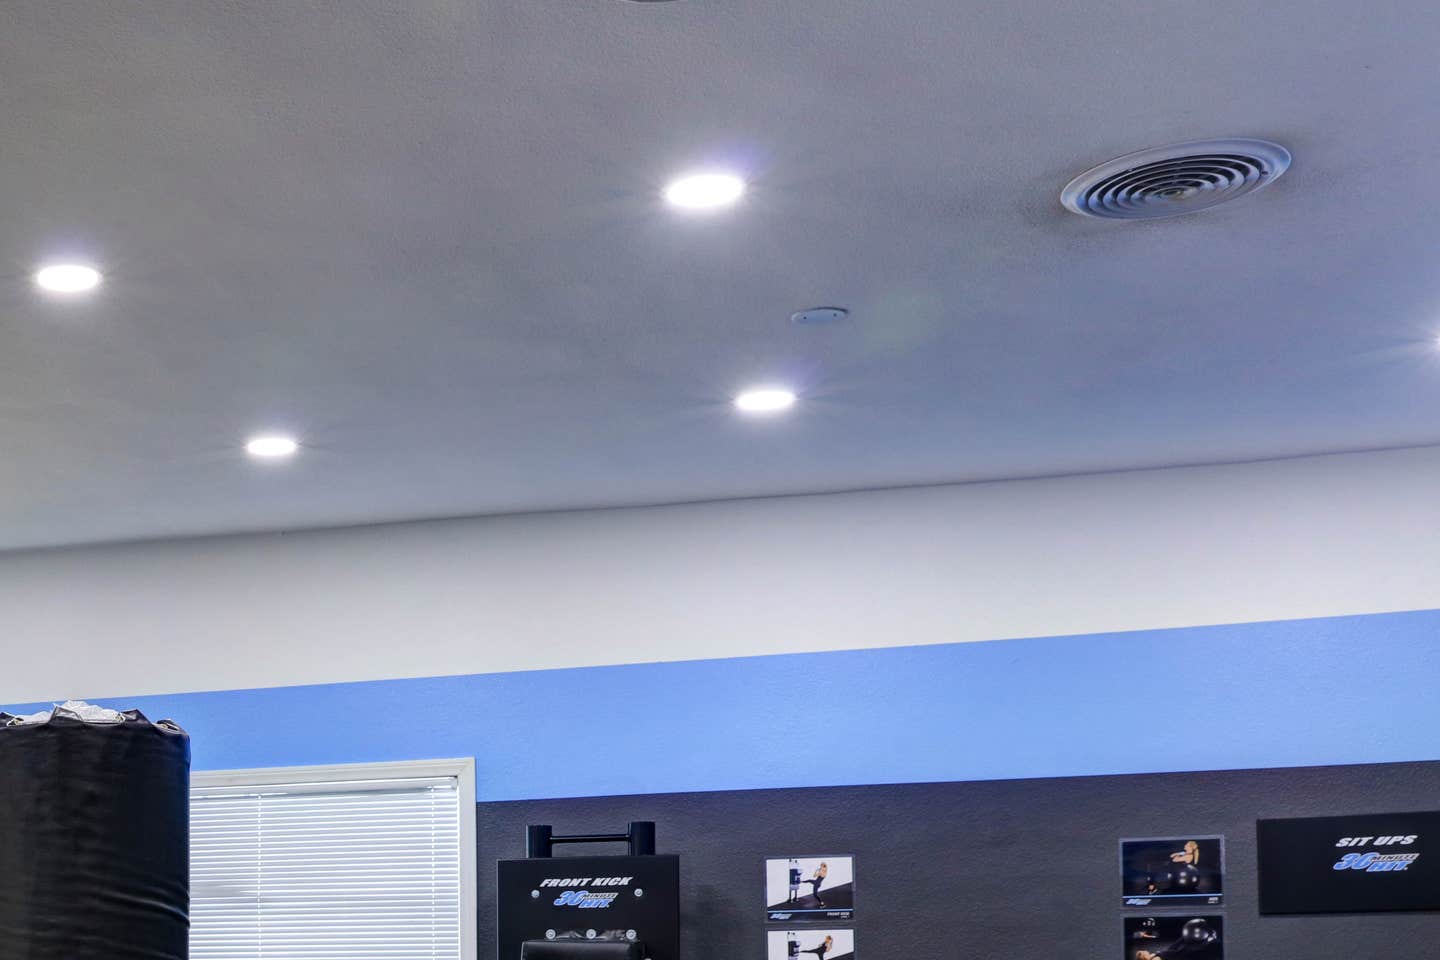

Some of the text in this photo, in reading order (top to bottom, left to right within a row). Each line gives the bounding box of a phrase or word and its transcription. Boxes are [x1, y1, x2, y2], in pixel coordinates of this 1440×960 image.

[1335, 835, 1418, 848] SIT UPS
[1333, 852, 1380, 870] 30
[540, 876, 634, 887] FRONT KICK
[553, 890, 590, 906] 30
